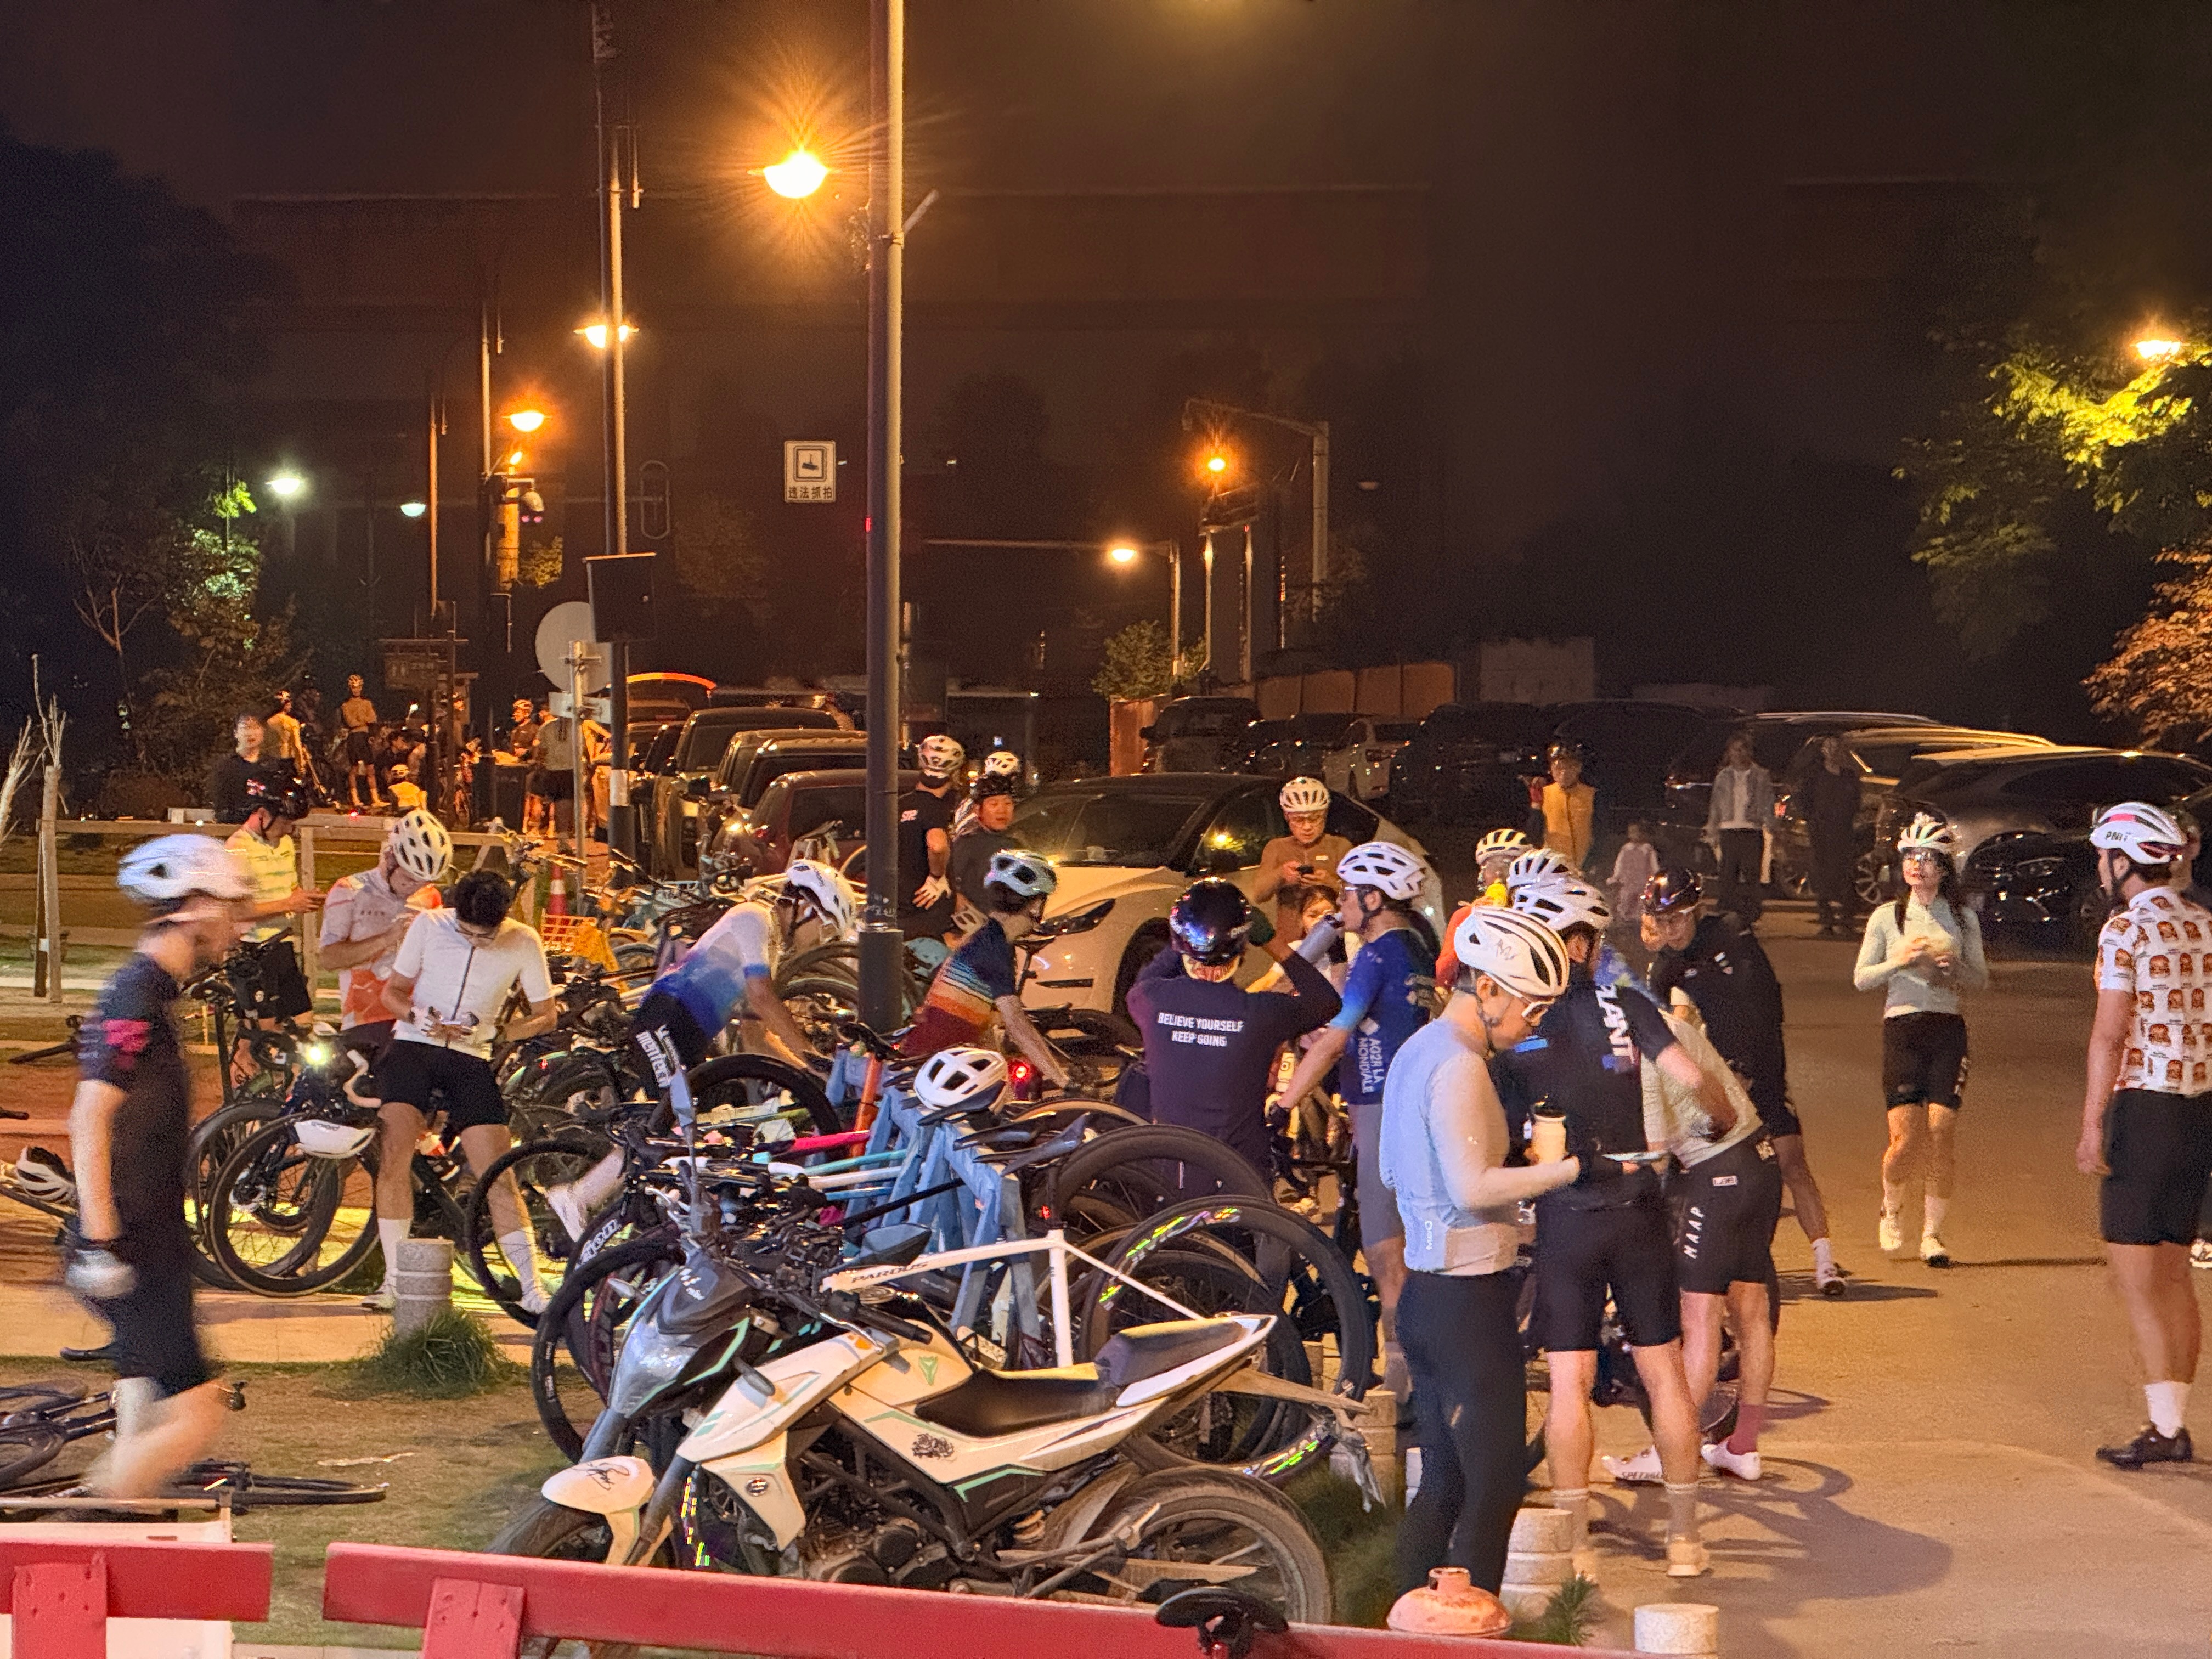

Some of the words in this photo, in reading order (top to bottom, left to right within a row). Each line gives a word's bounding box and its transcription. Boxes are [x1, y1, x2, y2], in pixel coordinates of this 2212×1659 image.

[1158, 1012, 1195, 1028] BELIEVE
[1196, 1018, 1244, 1032] YOURSELF
[1171, 1031, 1197, 1043] KEEP
[1197, 1034, 1228, 1047] GOING
[1358, 1037, 1374, 1094] MONDIALE
[1683, 1206, 1705, 1259] MAAP
